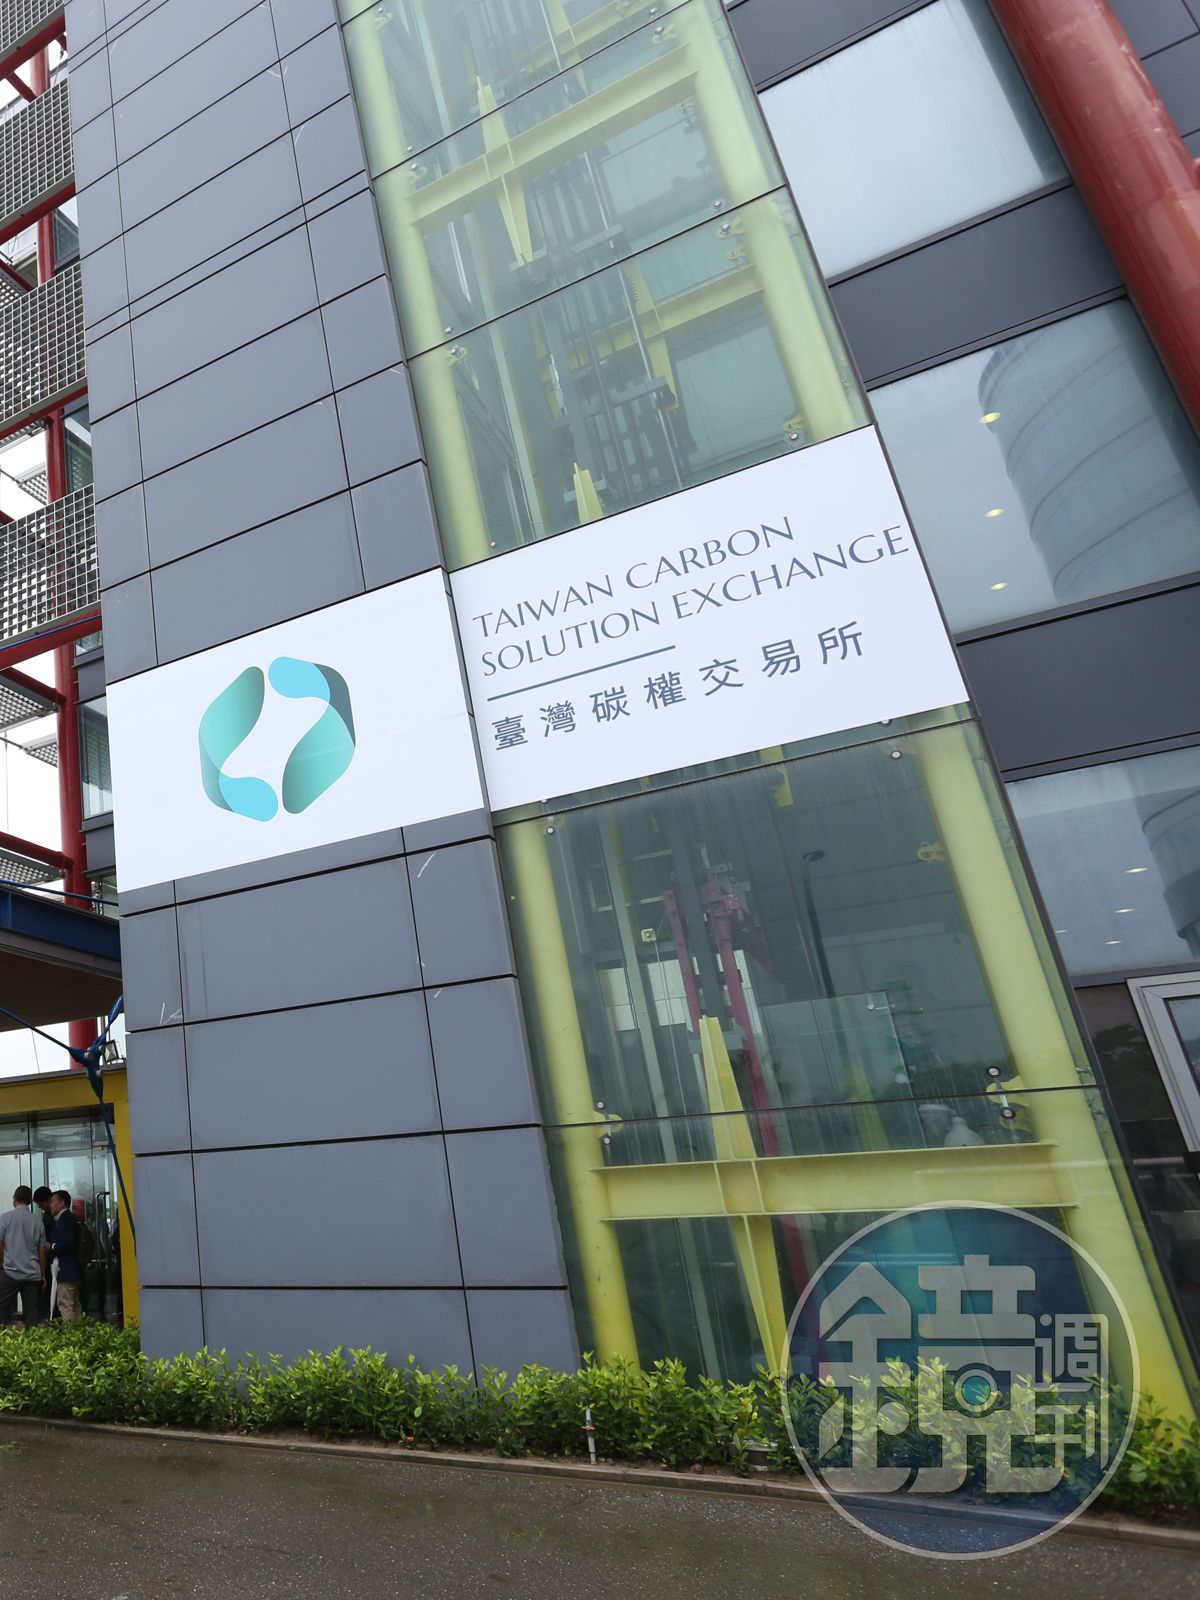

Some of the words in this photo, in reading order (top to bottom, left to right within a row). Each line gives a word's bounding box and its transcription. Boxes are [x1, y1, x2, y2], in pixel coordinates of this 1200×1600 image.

[473, 575, 614, 638] TAIWAN
[625, 516, 794, 589] CARBON
[483, 601, 660, 676] SOLUTION
[674, 525, 909, 620] EXCHANGE
[492, 621, 865, 751] 臺灣碳權交易所
